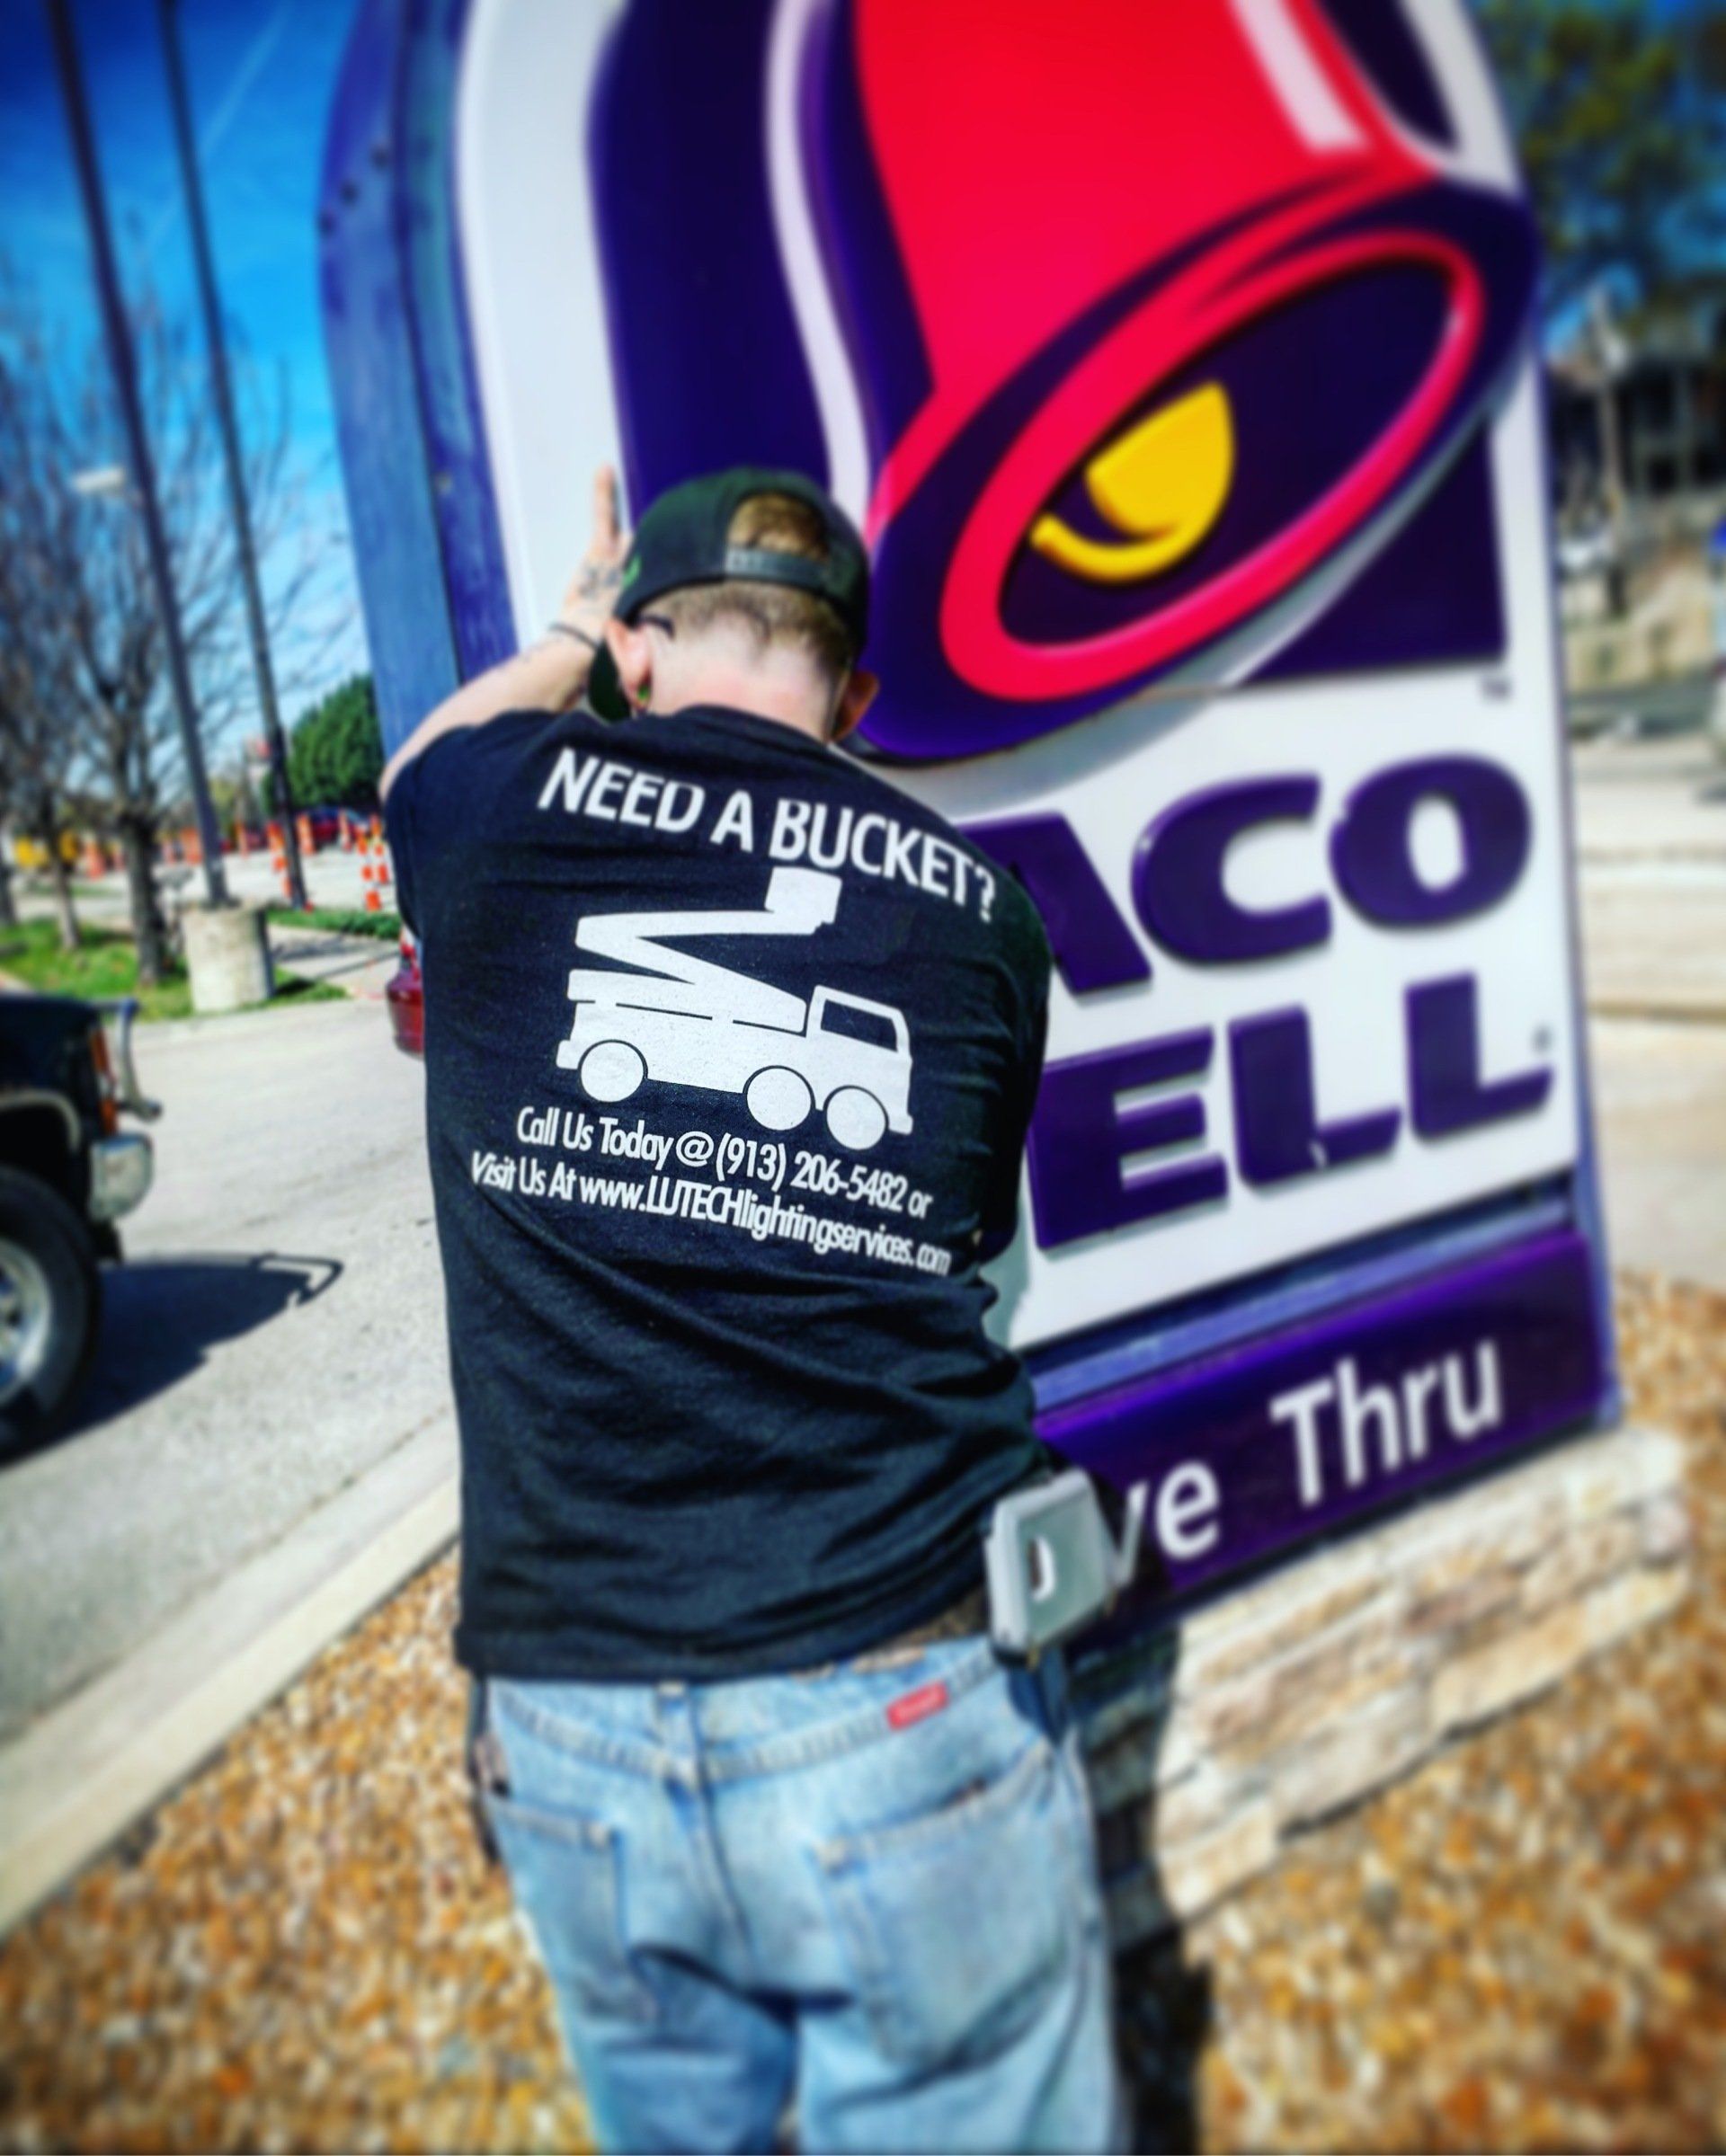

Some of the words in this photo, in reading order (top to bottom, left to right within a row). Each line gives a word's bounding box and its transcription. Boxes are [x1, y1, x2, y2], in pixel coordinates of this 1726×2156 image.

[538, 746, 706, 834] NEED
[710, 789, 754, 853] A
[769, 797, 996, 924] BUCKET?
[953, 751, 1535, 999] ACO
[471, 1150, 516, 1192] Visit
[519, 1156, 546, 1196] Us
[547, 1161, 576, 1202] At
[517, 1105, 560, 1147] Call
[563, 1111, 594, 1150] Us
[599, 1116, 674, 1171] Today
[675, 1131, 715, 1167] @
[716, 1131, 787, 1193] (913)
[790, 1150, 908, 1212] 206-5482
[907, 1170, 934, 1220] or
[1025, 970, 1554, 1252] ELL
[1269, 1339, 1503, 1508] Thru
